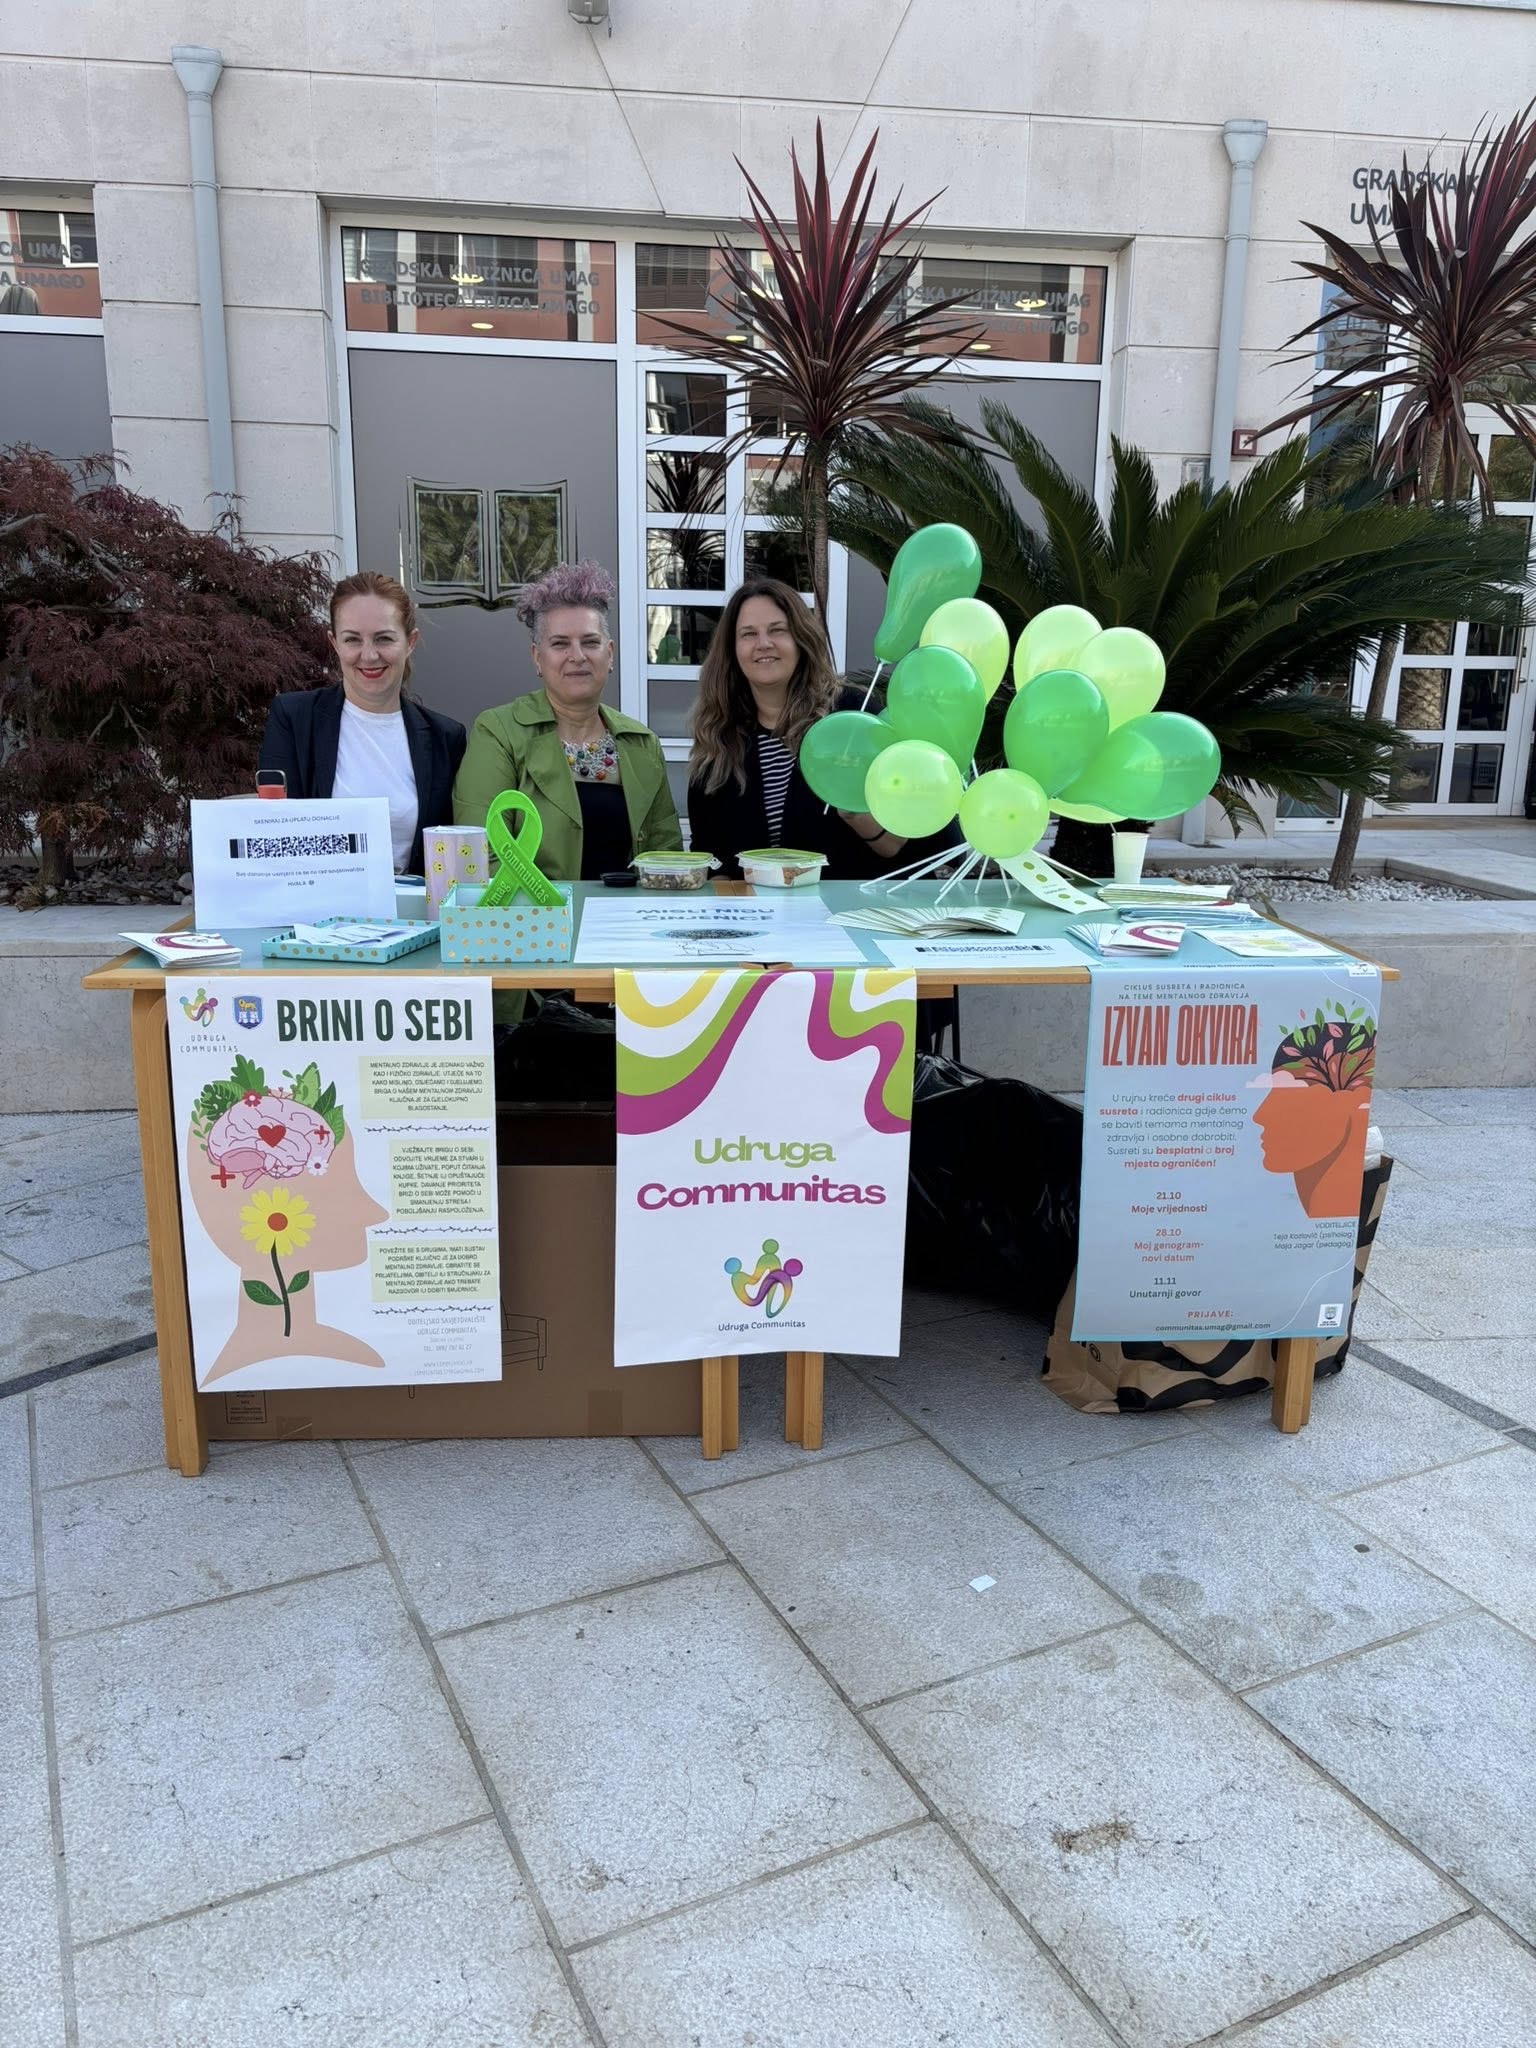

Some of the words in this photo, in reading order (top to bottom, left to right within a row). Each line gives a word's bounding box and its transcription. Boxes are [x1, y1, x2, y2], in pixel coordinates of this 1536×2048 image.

[1353, 167, 1458, 194] GRADSKA
[28, 242, 83, 259] UMAG
[18, 272, 85, 288] UMAGO
[550, 270, 600, 287] UMAG
[361, 289, 465, 309] BIBLIOTECA
[540, 299, 600, 315] UMAGO
[1045, 291, 1091, 308] UMAG
[500, 842, 549, 903] Communitas
[1124, 983, 1152, 991] CIKLUS
[1156, 983, 1190, 991] SUSRETA
[1157, 992, 1206, 1000] MENTALNOG
[277, 999, 363, 1042] BRINI
[375, 999, 393, 1041] O
[405, 999, 472, 1041] SEBI
[1102, 1005, 1169, 1066] IZVAN
[1176, 1004, 1259, 1066] OKVIRA
[1112, 1093, 1119, 1102] U
[1122, 1093, 1144, 1104] rujnu
[1147, 1092, 1175, 1102] kreće
[1178, 1092, 1205, 1103] drugi
[1207, 1092, 1236, 1102] ciklus
[1099, 1106, 1138, 1116] susreta
[1146, 1106, 1192, 1116] radionica
[1194, 1106, 1217, 1118] gdje
[1219, 1104, 1247, 1115] ćemo
[1115, 1119, 1142, 1128] baviti
[1144, 1120, 1188, 1128] temama
[1190, 1118, 1243, 1131] mentalnog
[1107, 1132, 1145, 1144] zdravlja
[1152, 1132, 1188, 1142] osobne
[1191, 1131, 1237, 1142] dobrobiti.
[694, 1136, 836, 1168] Udruga
[1107, 1146, 1138, 1155] Susreti
[1156, 1145, 1203, 1158] besplatni
[1215, 1145, 1234, 1157] broj
[1124, 1158, 1159, 1170] mjesta
[1162, 1157, 1216, 1171] ograničen!
[637, 1175, 886, 1210] Communitas
[1156, 1191, 1181, 1200] 21.10
[1131, 1204, 1155, 1216] Moje
[1157, 1203, 1207, 1215] vrijednosti
[1155, 1228, 1181, 1237] 28.10
[1134, 1241, 1152, 1252] Moj
[1154, 1241, 1204, 1252] genogram-
[1142, 1253, 1162, 1262] novi
[1164, 1252, 1194, 1262] datum
[1153, 1277, 1177, 1286] 11.11
[1129, 1289, 1173, 1300] Unutarnji
[1176, 1289, 1202, 1299] govor
[1188, 1310, 1234, 1319] PRIJAVE:
[718, 1322, 749, 1332] Udruga
[751, 1319, 806, 1329] Communitas
[1155, 1322, 1271, 1332] communitas.umag@gmail.com
